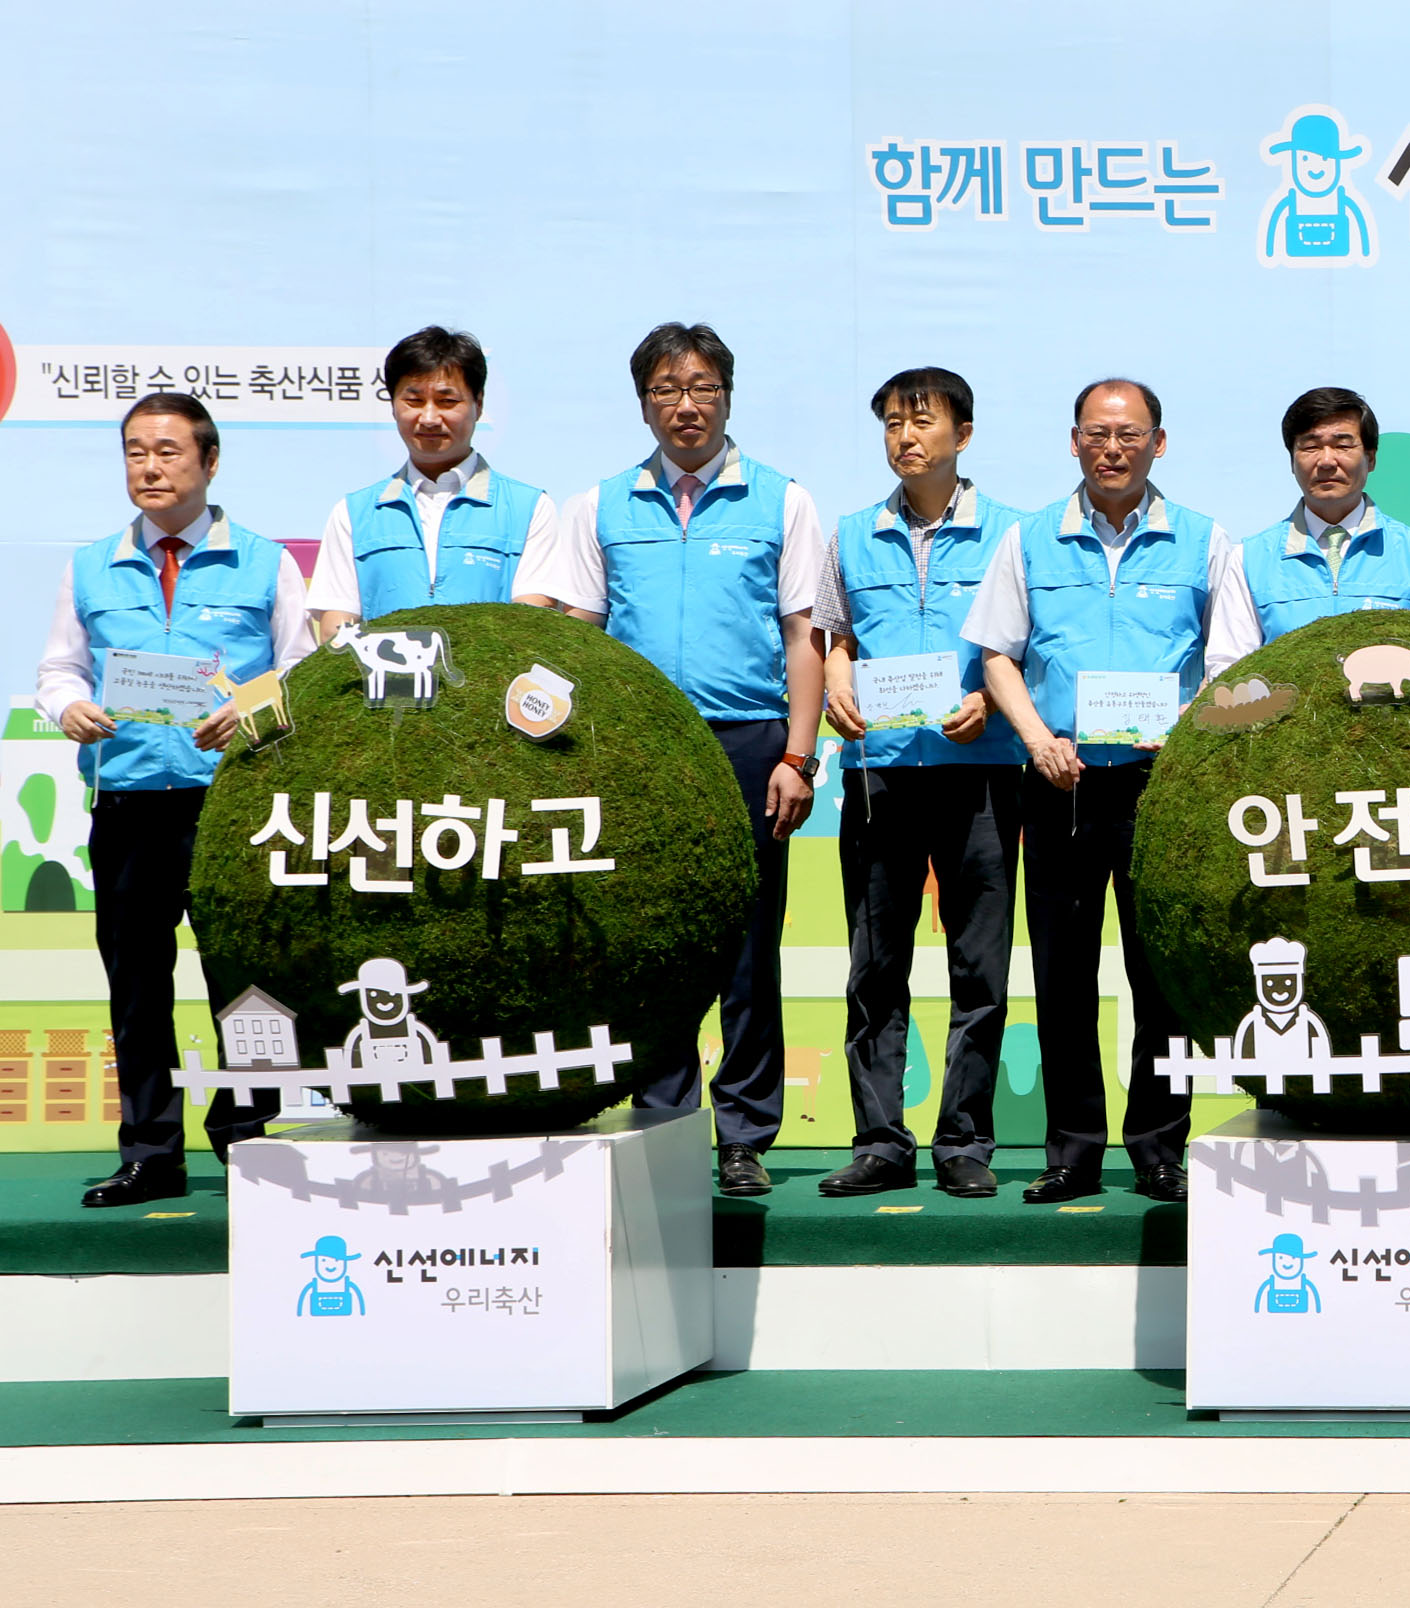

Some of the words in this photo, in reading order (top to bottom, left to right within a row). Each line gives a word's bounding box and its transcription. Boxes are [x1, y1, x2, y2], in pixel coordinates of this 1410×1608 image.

[871, 142, 1004, 227] 함께
[1026, 145, 1220, 227] 만드는
[146, 363, 177, 399] 수
[184, 363, 242, 400] 있는
[248, 363, 364, 402] 축산식품
[522, 700, 546, 718] HONEY
[526, 694, 550, 711] HONEY
[249, 791, 616, 893] 신선하고
[373, 1247, 539, 1284] 신선에너지
[440, 1286, 543, 1316] 우리축산
